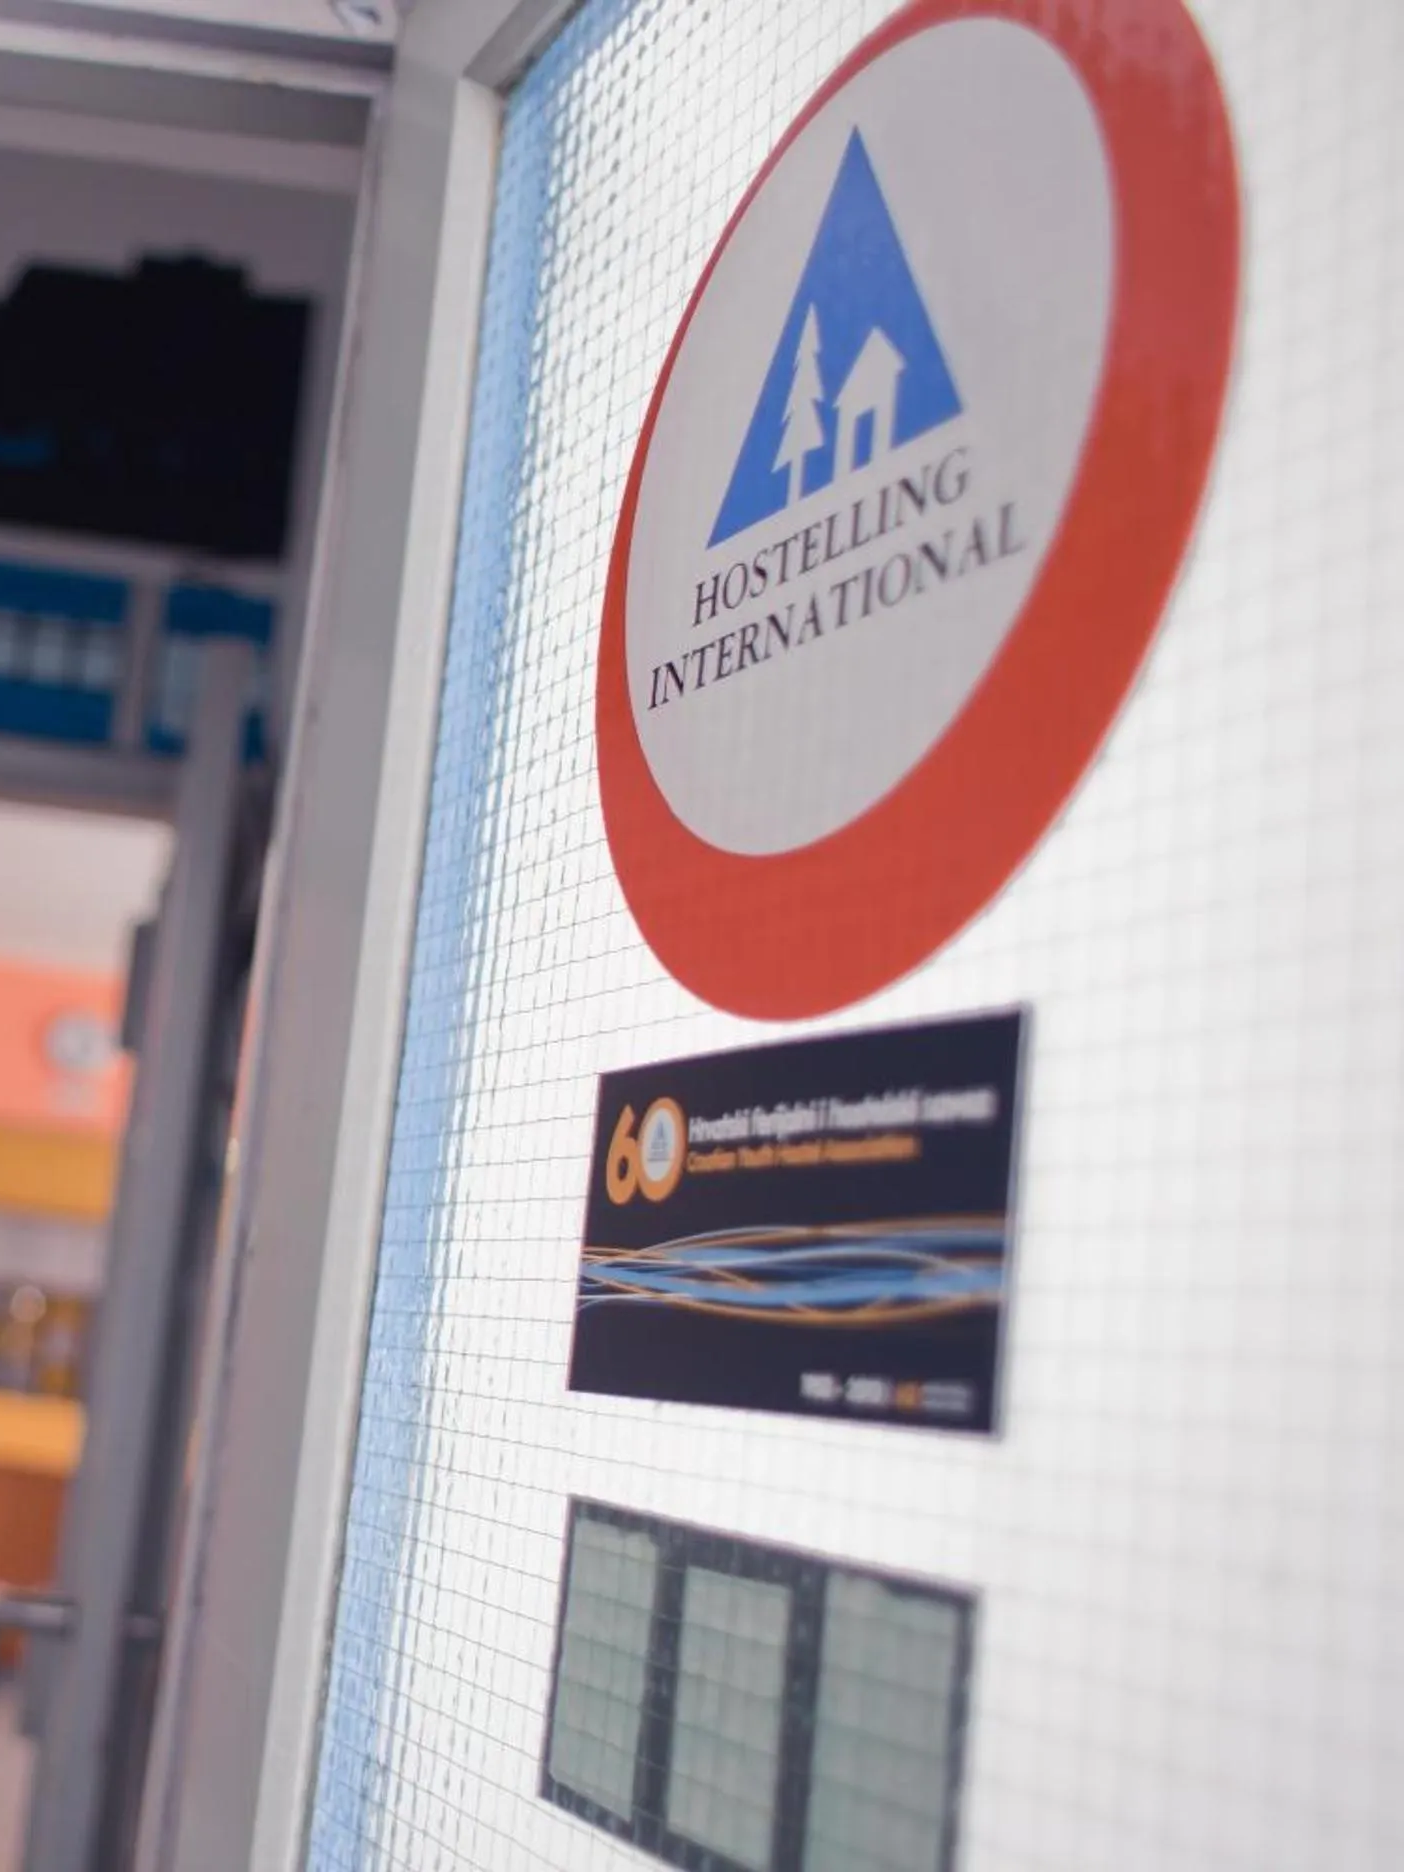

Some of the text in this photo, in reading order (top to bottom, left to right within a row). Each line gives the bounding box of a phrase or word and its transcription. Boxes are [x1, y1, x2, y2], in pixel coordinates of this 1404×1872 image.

[647, 502, 1029, 711] INTERNATIONAL
[692, 446, 972, 627] HOSTELLING
[606, 1097, 687, 1204] 60
